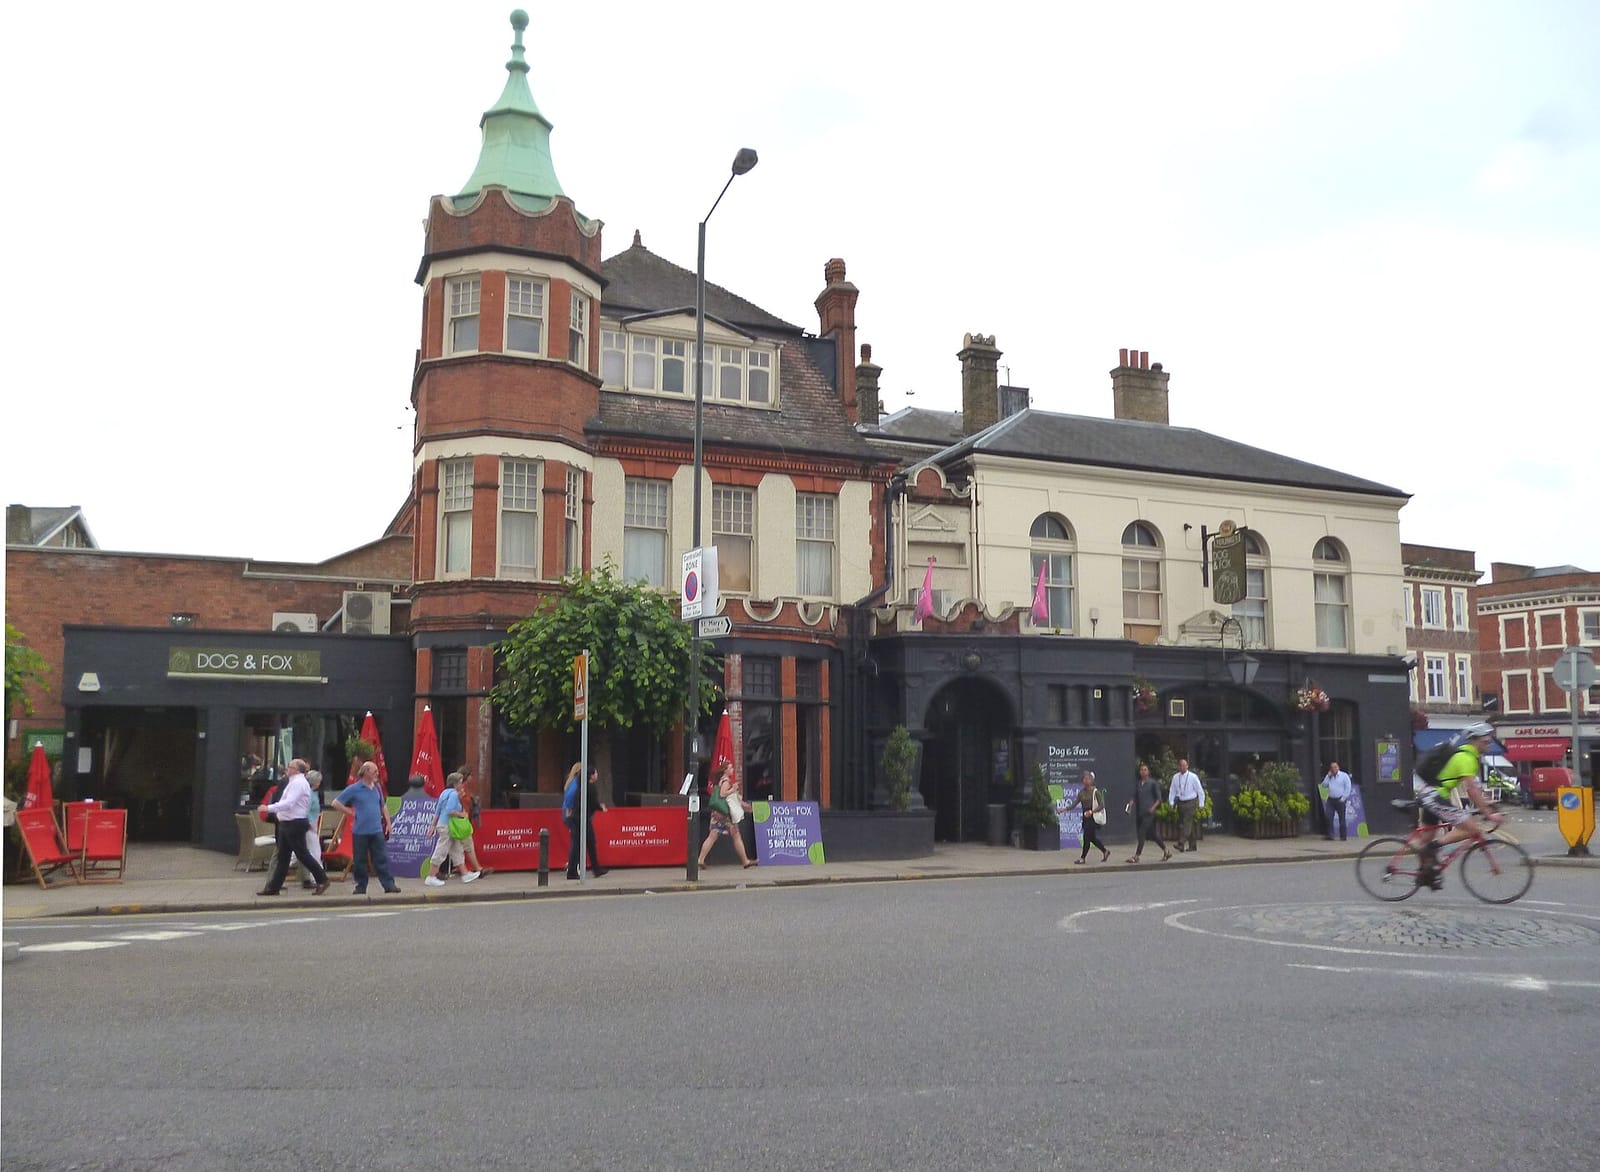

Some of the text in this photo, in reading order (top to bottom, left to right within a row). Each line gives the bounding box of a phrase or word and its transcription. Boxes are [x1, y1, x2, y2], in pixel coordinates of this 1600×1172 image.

[1213, 549, 1229, 560] DOG
[197, 653, 293, 671] DOG & FOX
[1049, 746, 1065, 758] Dog
[1072, 745, 1089, 756] Fox
[773, 805, 812, 816] DOG FOX
[483, 842, 520, 850] BEAUTIFULLY
[769, 839, 774, 848] 5
[774, 839, 785, 848] BIG
[785, 838, 807, 848] SCREENS
